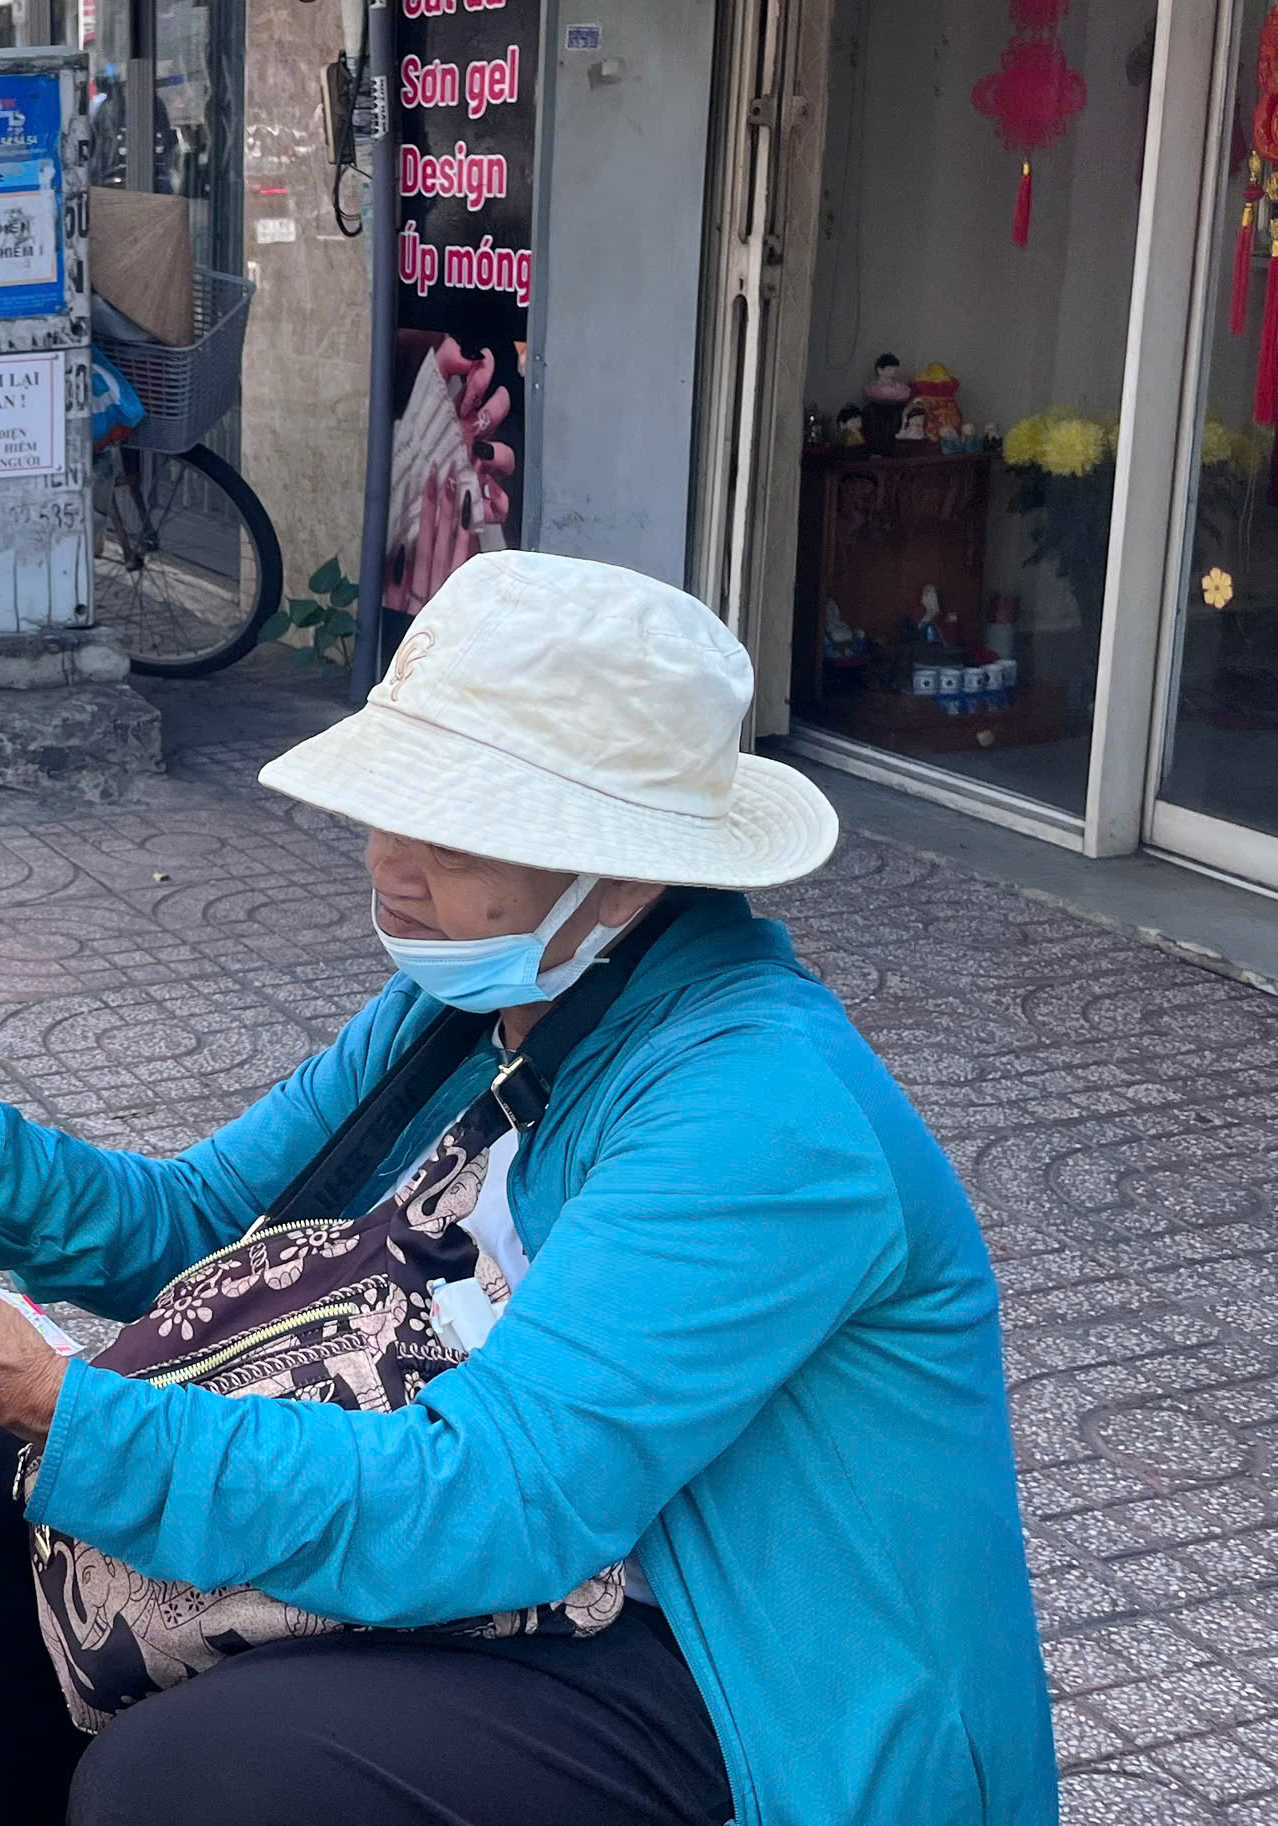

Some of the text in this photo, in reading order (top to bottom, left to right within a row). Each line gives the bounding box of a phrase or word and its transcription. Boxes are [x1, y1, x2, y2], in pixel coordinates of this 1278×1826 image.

[401, 54, 460, 108] Sơn
[466, 45, 520, 119] gel
[400, 141, 508, 211] Design
[399, 220, 533, 307] Úp móng
[10, 371, 40, 390] LẠI
